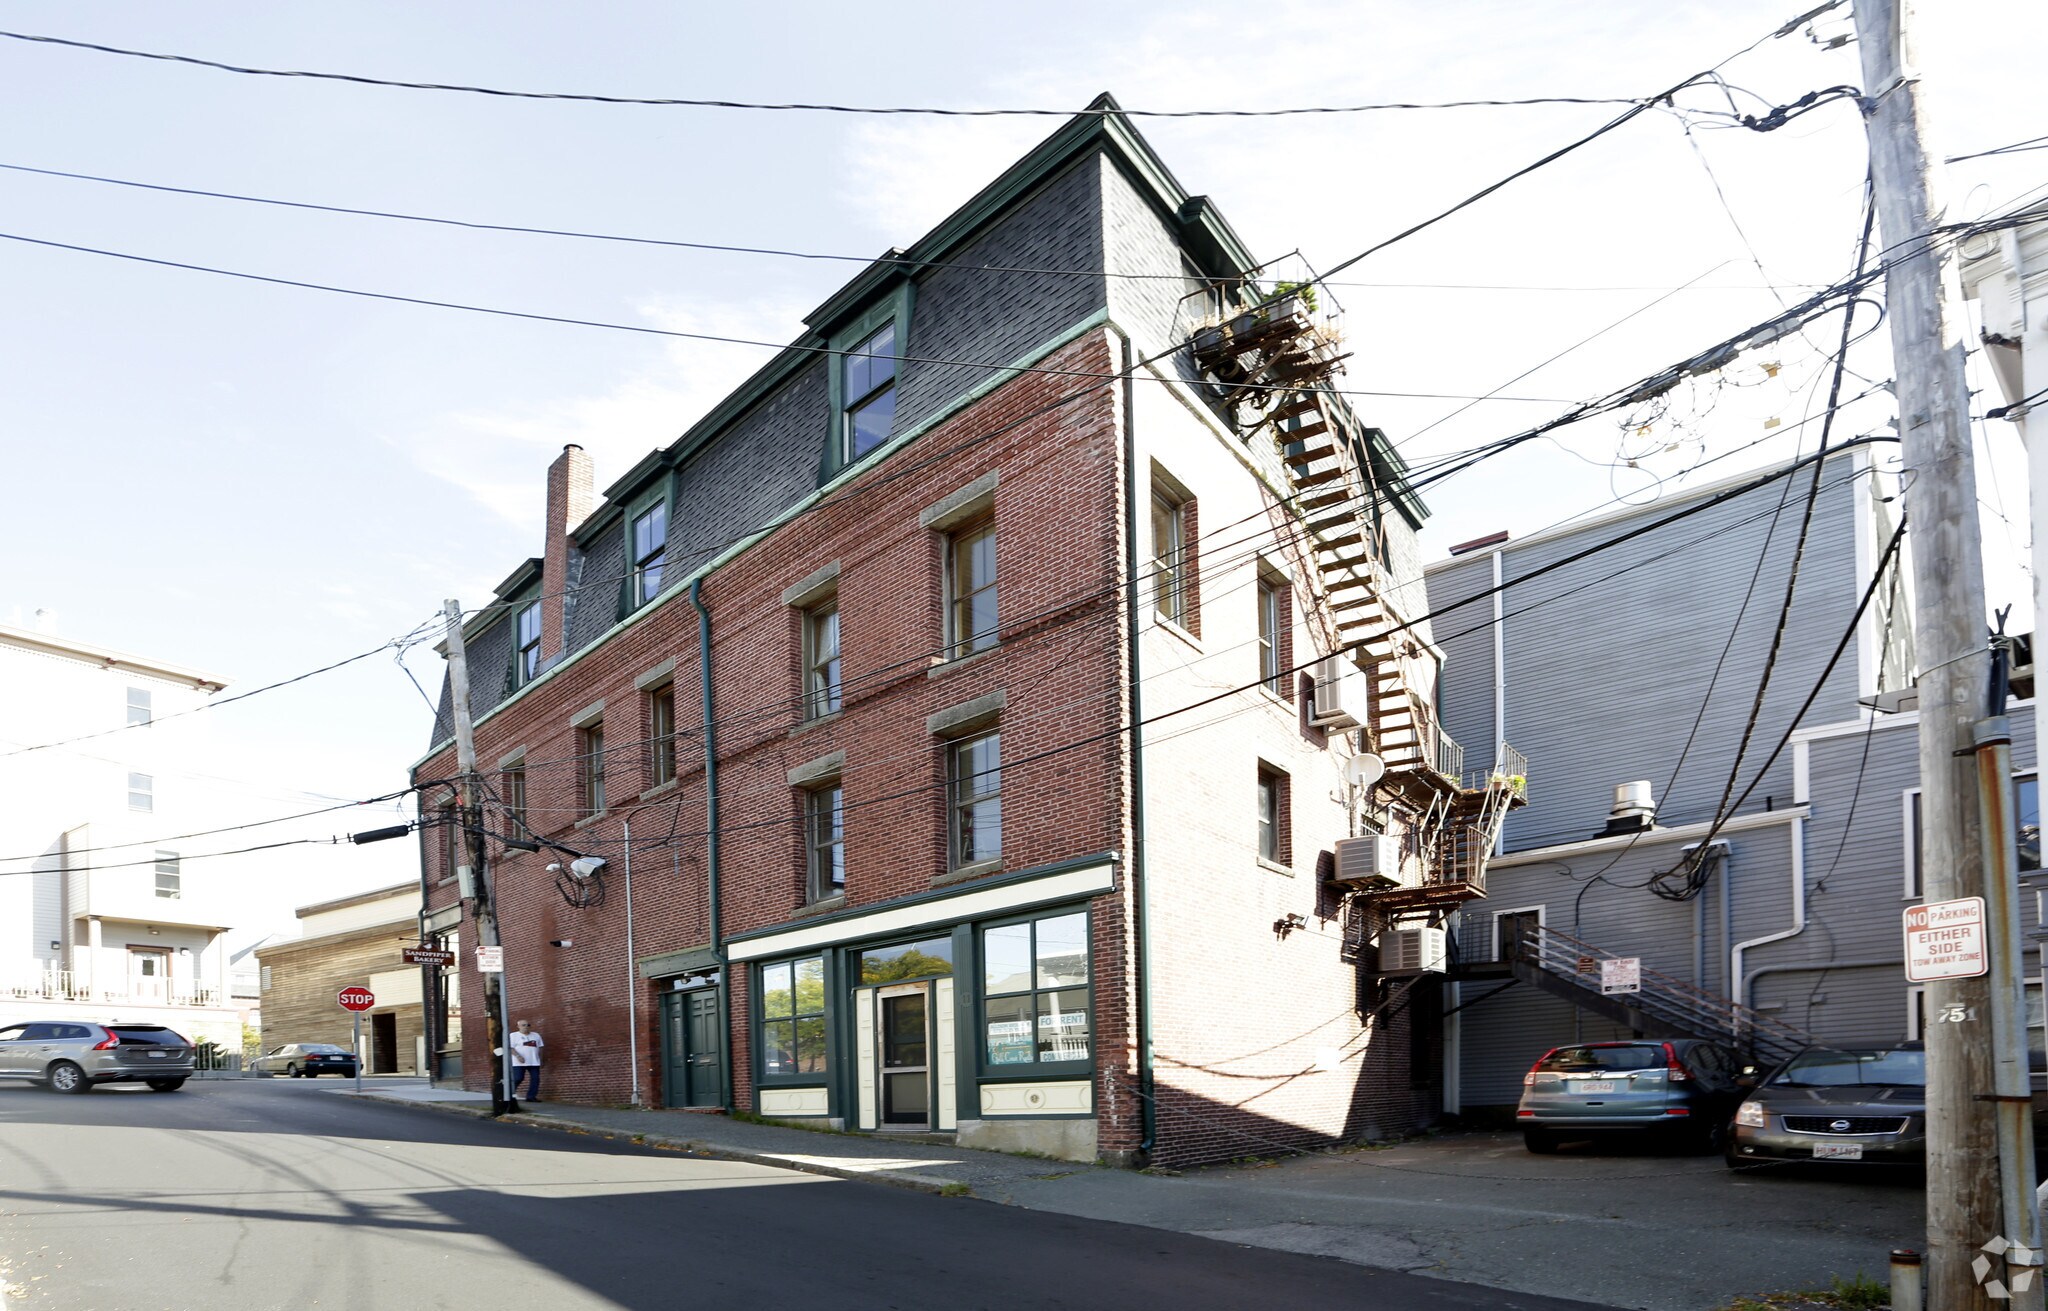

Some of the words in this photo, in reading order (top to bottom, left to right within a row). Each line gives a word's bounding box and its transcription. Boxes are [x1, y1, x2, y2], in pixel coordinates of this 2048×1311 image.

[1907, 912, 1927, 927] NO
[1930, 907, 1977, 921] PARKING
[1918, 927, 1972, 944] EITHER
[405, 950, 452, 958] SANDPIPER
[1928, 941, 1963, 956] SIDE
[413, 956, 444, 964] BAKERY
[1913, 959, 1931, 967] TOW
[1933, 955, 1956, 964] AWAY
[1960, 952, 1980, 961] ZONE
[340, 994, 373, 1004] STOP
[1060, 1015, 1084, 1024] RENT
